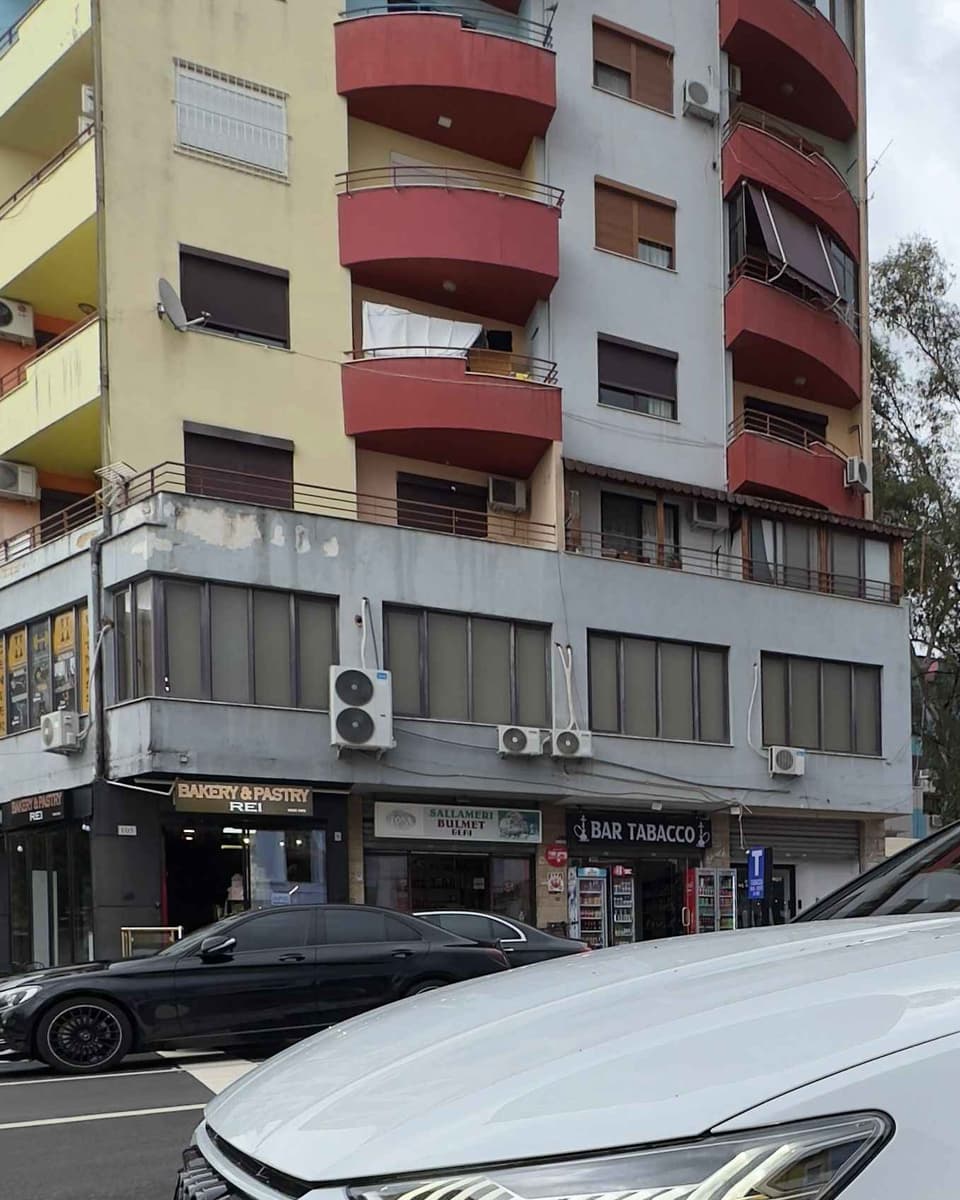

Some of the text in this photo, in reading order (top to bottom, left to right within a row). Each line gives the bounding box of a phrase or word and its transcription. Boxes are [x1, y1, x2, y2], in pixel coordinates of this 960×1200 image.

[178, 783, 310, 802] BAKERY & PASTRY
[230, 801, 263, 812] REI
[29, 810, 43, 821] REI
[430, 808, 494, 820] SALLAMERI
[437, 819, 486, 829] BULMET
[591, 821, 695, 843] BAR TABACCO
[751, 850, 763, 876] T
